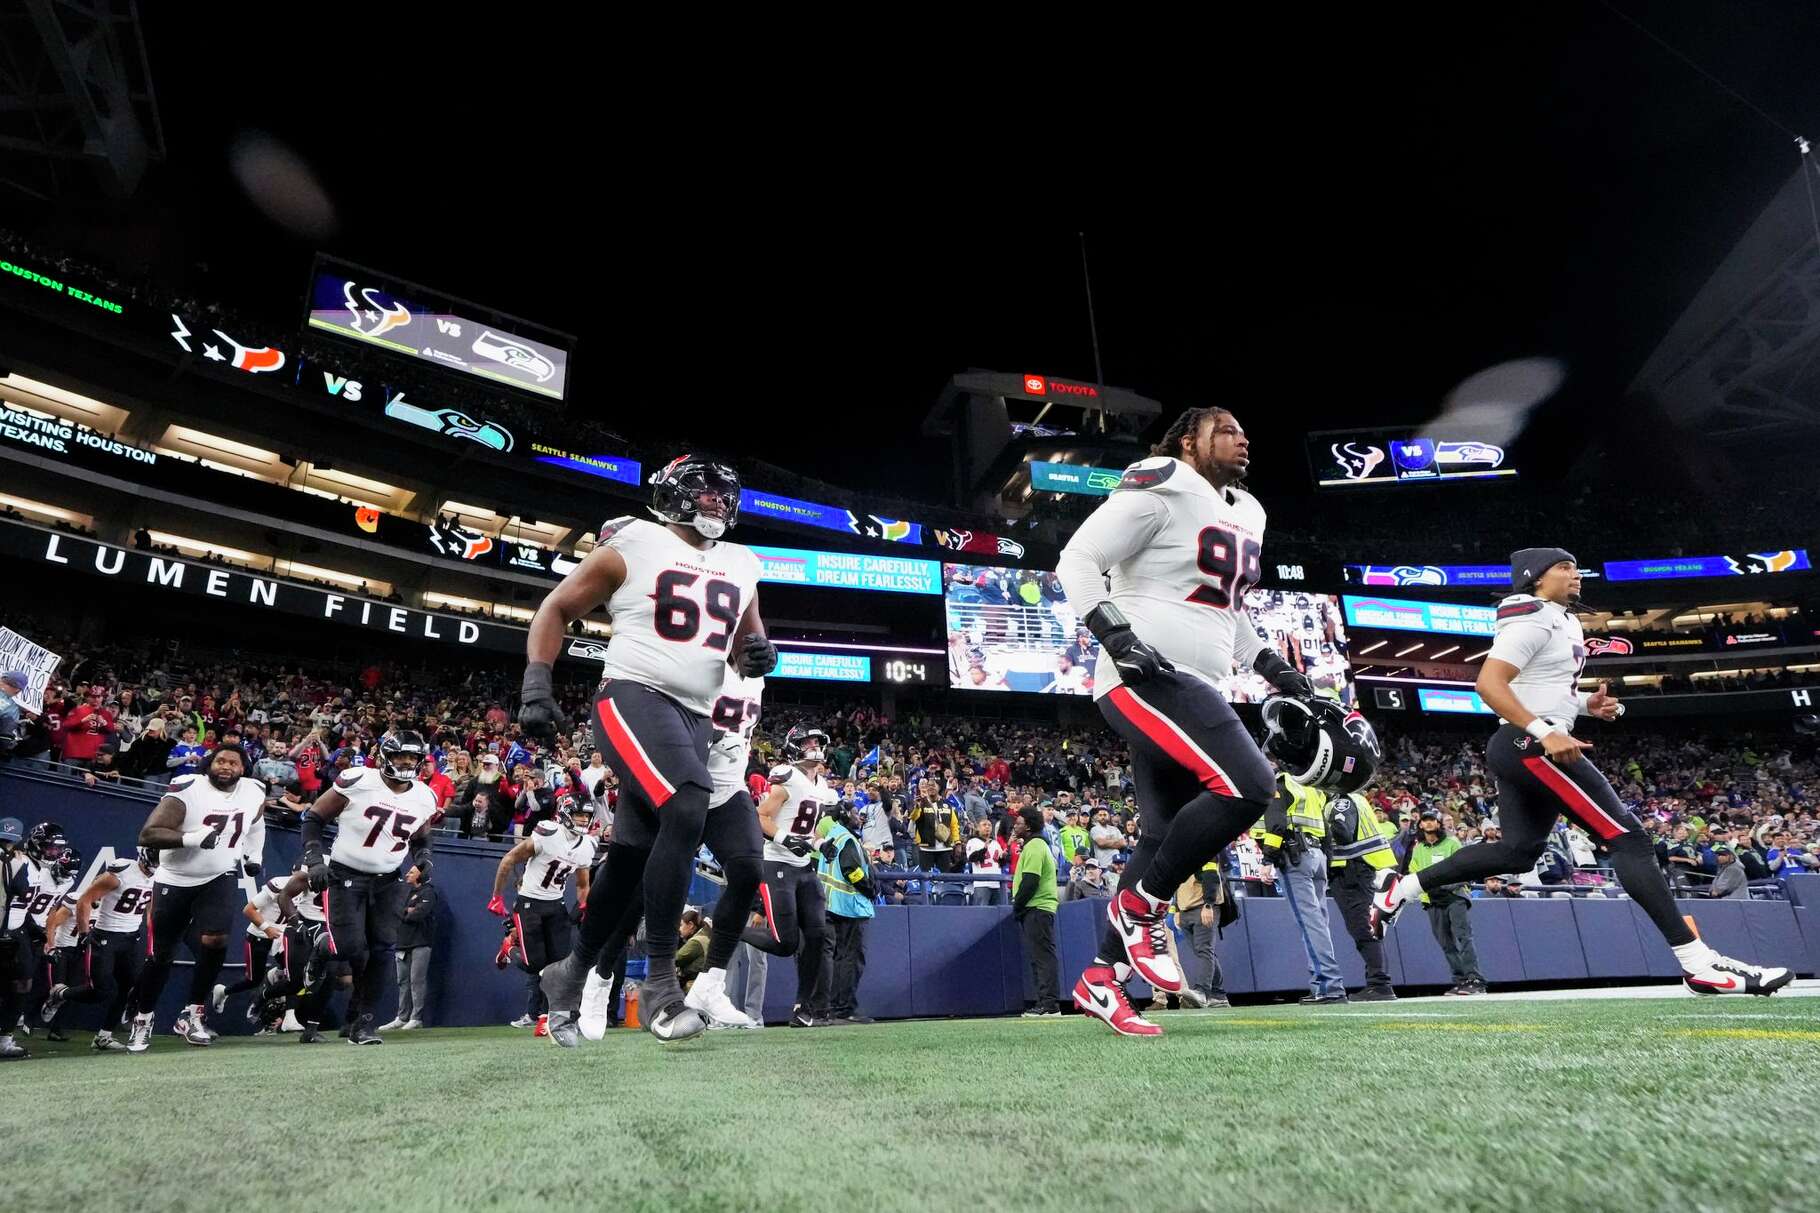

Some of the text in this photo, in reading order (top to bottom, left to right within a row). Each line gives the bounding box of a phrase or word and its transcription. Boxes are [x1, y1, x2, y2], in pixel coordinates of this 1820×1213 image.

[0, 261, 122, 314] OUSTON TEXANS
[436, 318, 462, 338] VS
[323, 371, 362, 402] VS
[1050, 382, 1099, 397] TOYOTA
[0, 407, 157, 465] VISITING HOUSTON
[531, 442, 618, 472] SEATTLE SEAHAWKS
[1400, 445, 1422, 457] VS
[753, 498, 792, 514] HOUSTON
[517, 546, 539, 561] VS
[816, 554, 861, 573] INSURE
[674, 561, 726, 577] HOUSTON
[816, 569, 859, 586] DREAM
[861, 575, 932, 593] FEARLESSLY
[1276, 564, 1305, 581] 10:48
[45, 534, 480, 644] LUMEN FIELD
[646, 569, 741, 653] 69
[1791, 689, 1812, 707] H
[202, 811, 244, 849] 71
[362, 805, 417, 853] 75
[113, 887, 152, 915] 82
